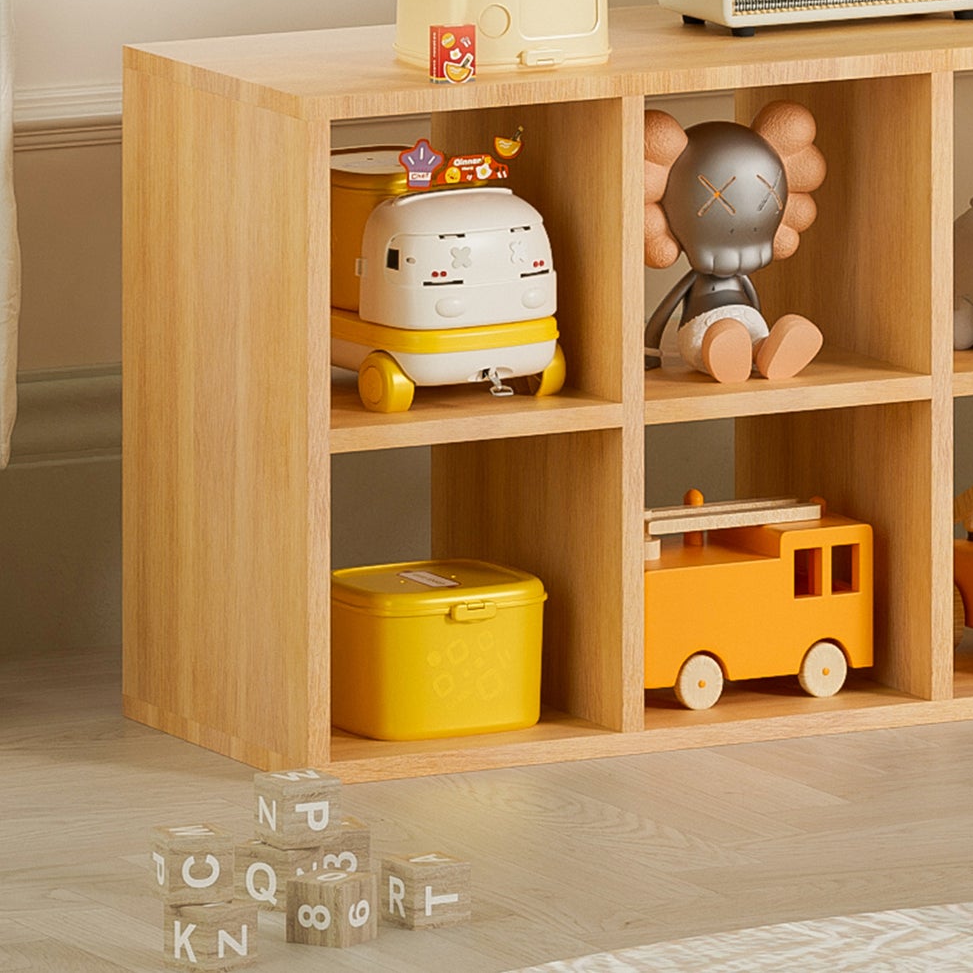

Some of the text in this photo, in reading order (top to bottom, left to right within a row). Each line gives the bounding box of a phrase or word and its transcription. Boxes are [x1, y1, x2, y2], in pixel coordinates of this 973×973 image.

[411, 172, 430, 180] Chef
[258, 795, 277, 832] N
[295, 801, 329, 831] P
[152, 851, 165, 886] P
[182, 854, 220, 888] C
[323, 851, 358, 873] 3
[245, 862, 278, 906] Q
[389, 875, 406, 919] R
[425, 885, 459, 917] T
[298, 904, 331, 931] 8
[174, 920, 198, 964] K
[218, 924, 248, 959] N
